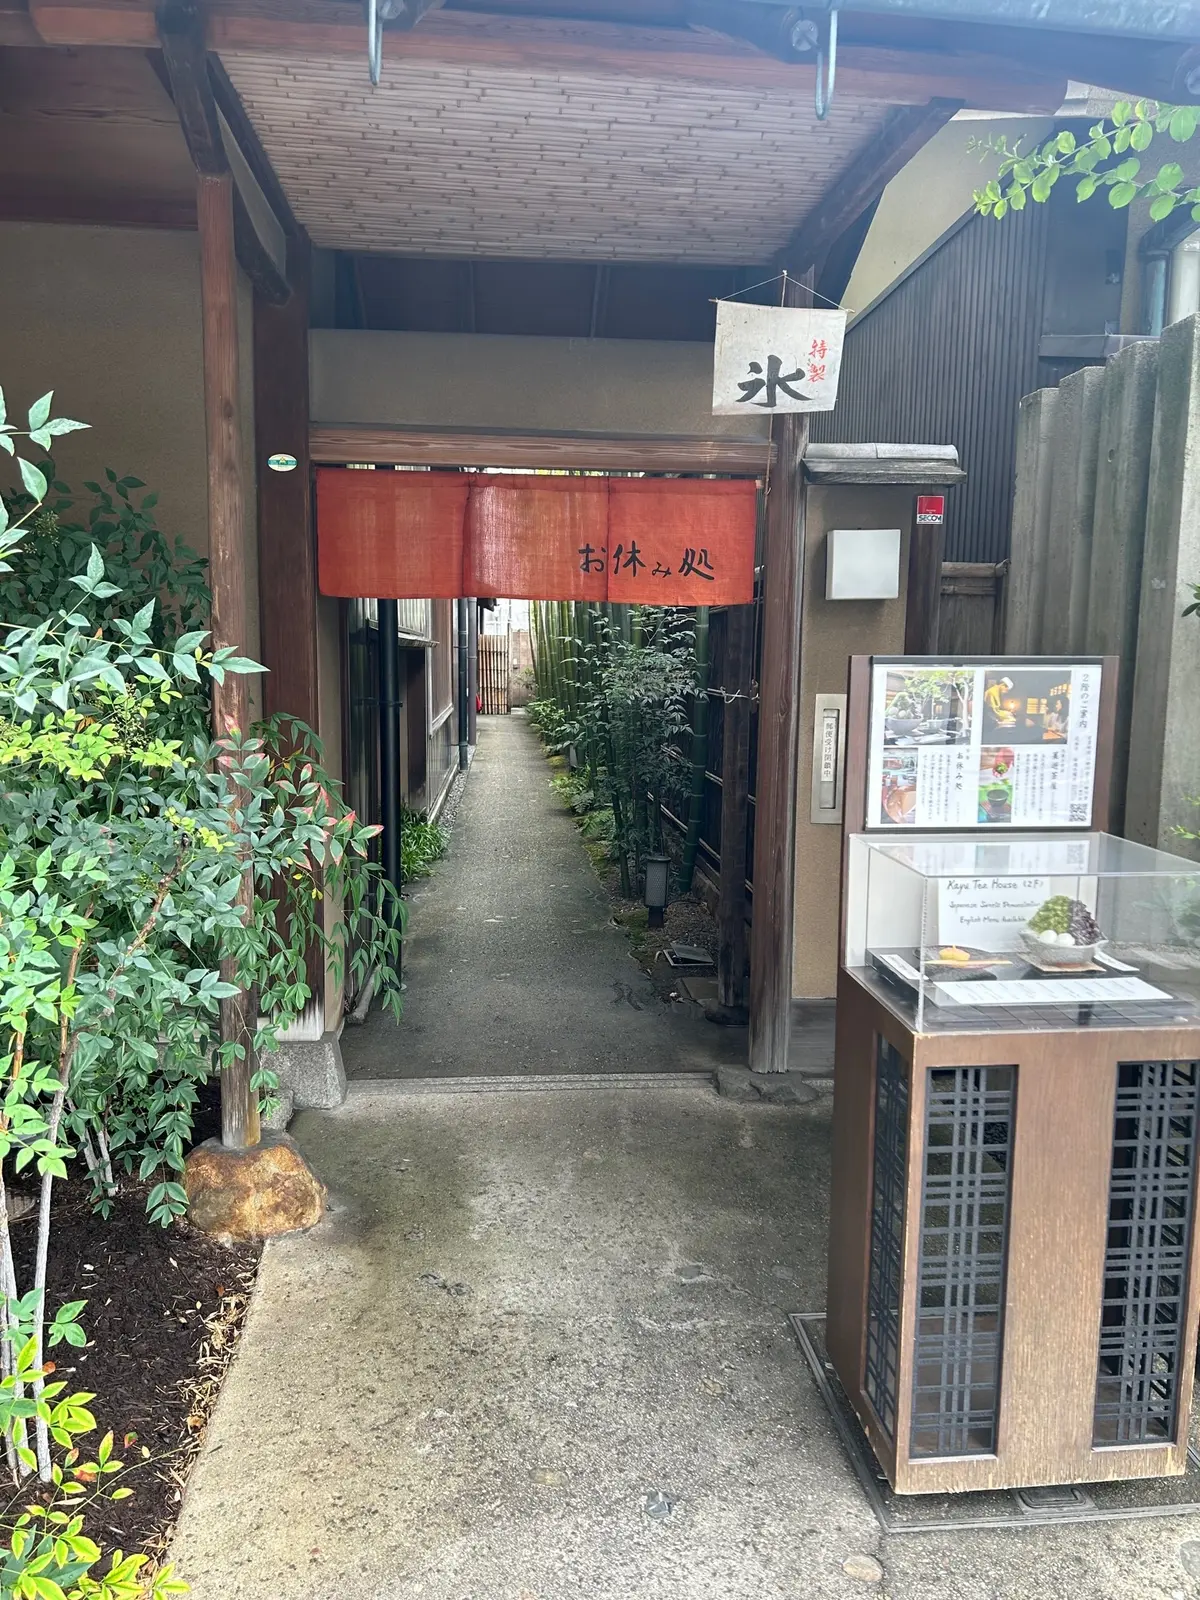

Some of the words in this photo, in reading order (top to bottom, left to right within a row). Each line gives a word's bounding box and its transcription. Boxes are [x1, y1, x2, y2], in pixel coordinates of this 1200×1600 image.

[808, 339, 828, 383] 特製
[735, 354, 813, 408] 氷
[918, 514, 942, 522] SECOM
[578, 540, 715, 581] お休み処
[956, 752, 964, 790] お休み処
[946, 880, 970, 895] Kayu
[973, 879, 988, 890] Tea
[992, 878, 1018, 889] House
[1023, 879, 1044, 890] (2F)
[960, 916, 981, 925] English
